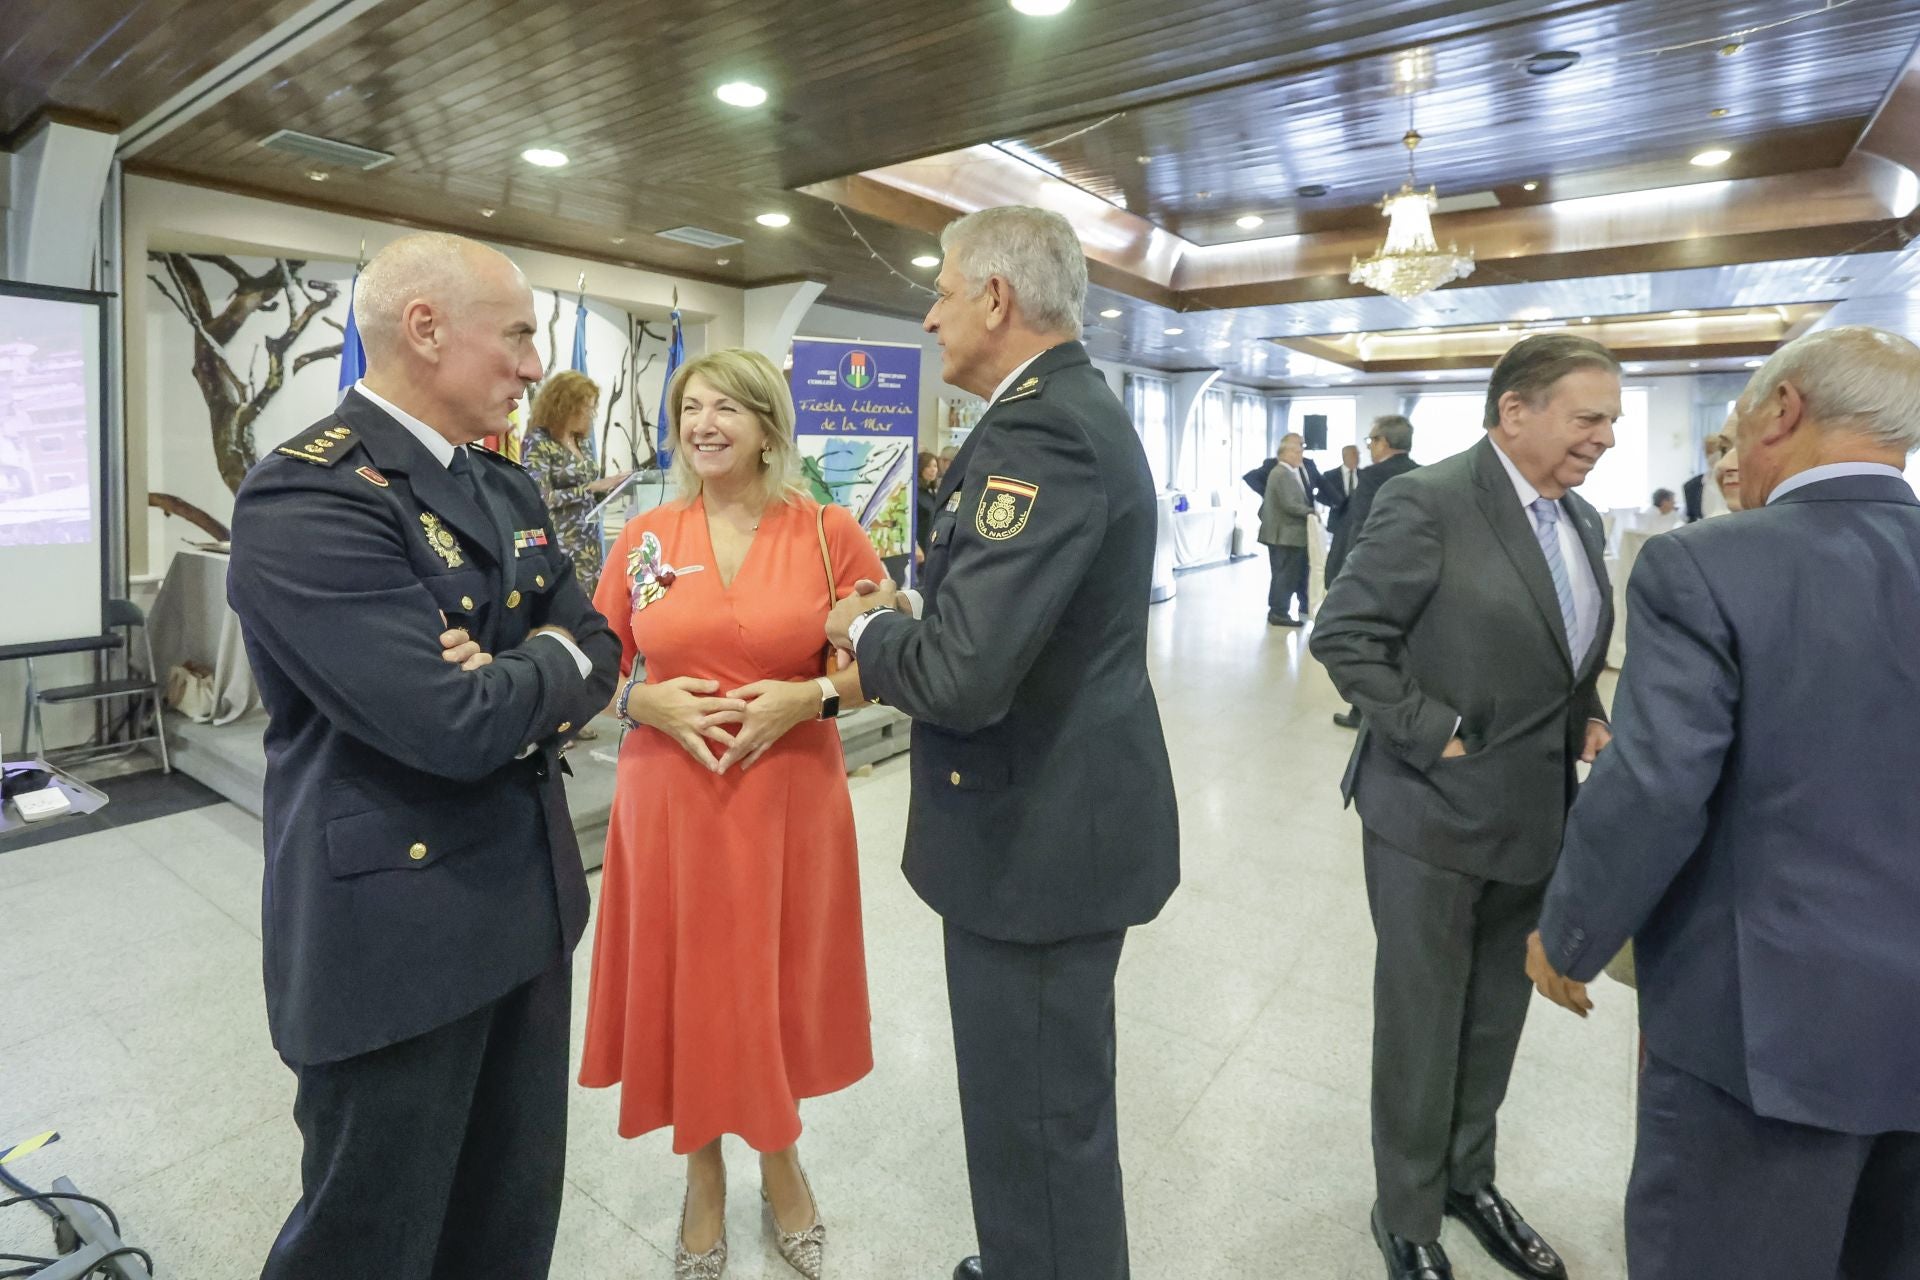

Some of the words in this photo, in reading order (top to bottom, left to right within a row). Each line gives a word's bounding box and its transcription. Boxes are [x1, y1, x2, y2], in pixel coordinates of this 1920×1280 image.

[799, 399, 846, 412] Fiesta
[851, 400, 913, 414] Literaria
[821, 418, 836, 430] de
[842, 416, 857, 431] la
[862, 418, 893, 431] Mar
[989, 511, 1027, 537] NACIONAL
